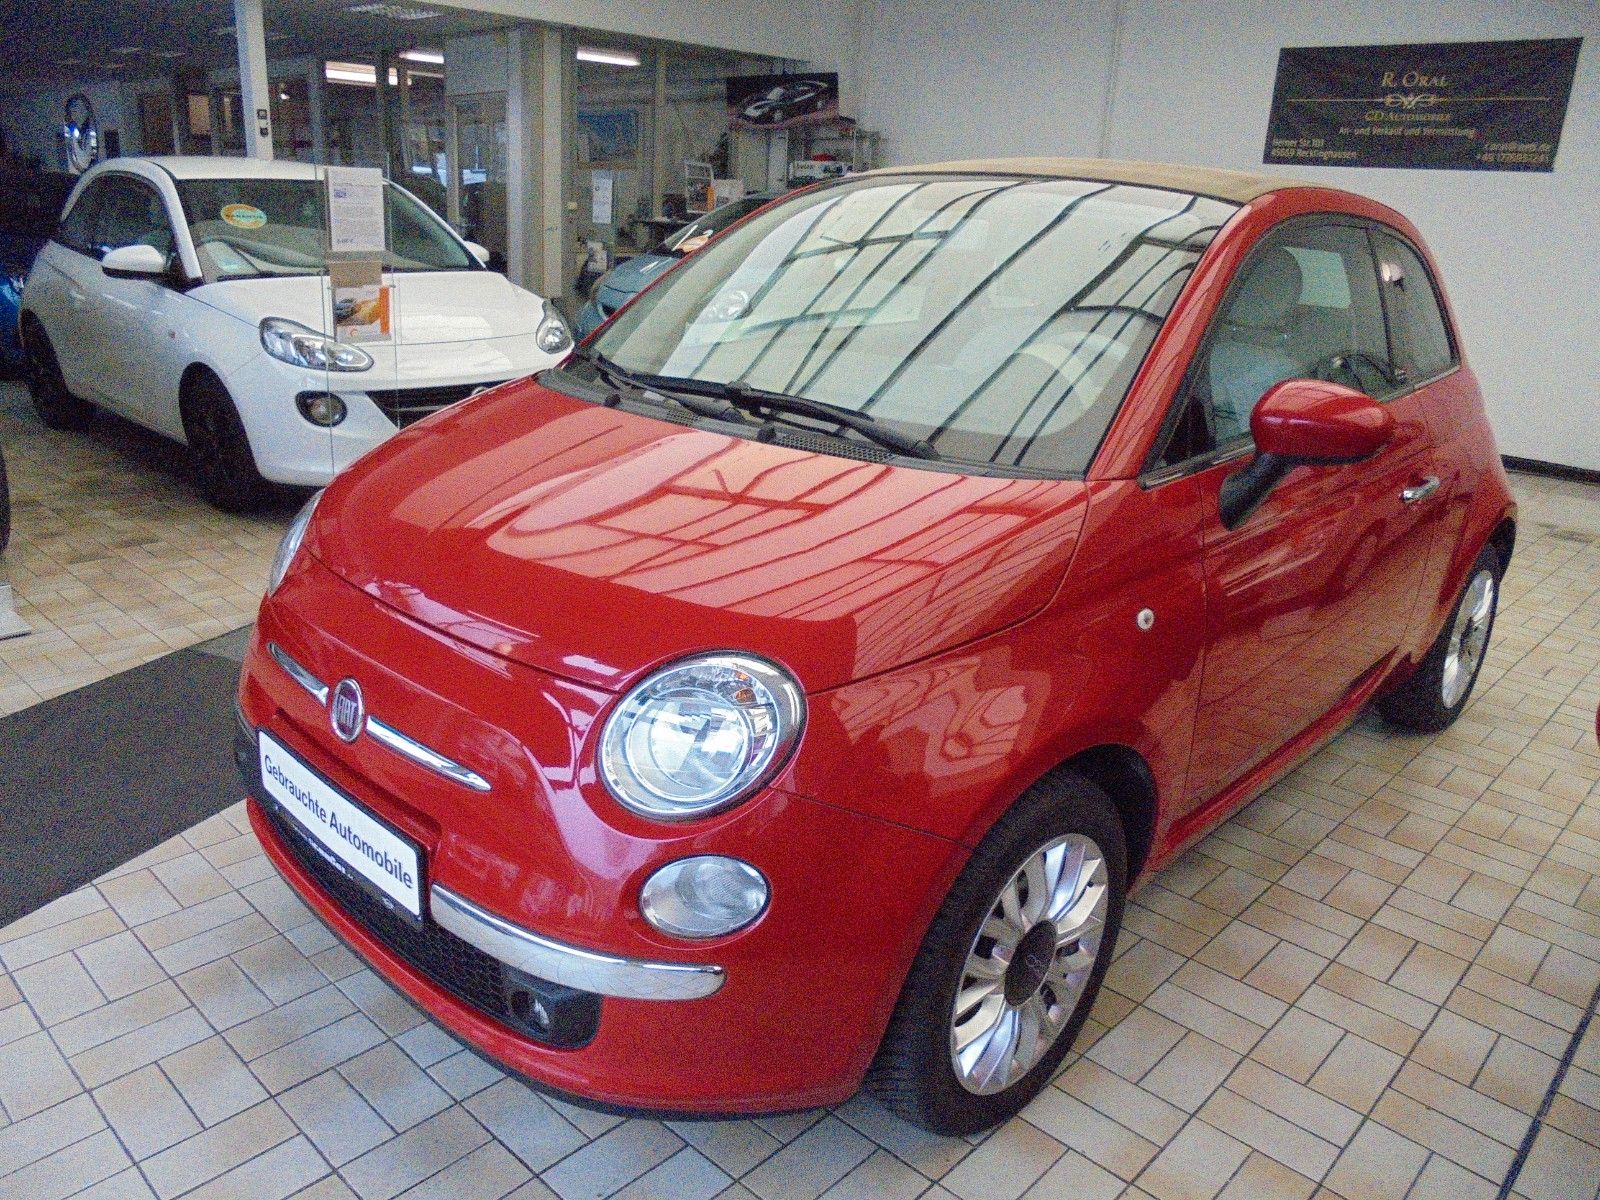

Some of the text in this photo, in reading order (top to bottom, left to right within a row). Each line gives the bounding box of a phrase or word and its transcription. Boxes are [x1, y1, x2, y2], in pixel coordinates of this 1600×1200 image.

[337, 694, 358, 729] FIAT
[264, 754, 327, 823] Gebrauchte
[329, 811, 414, 890] Automobile
